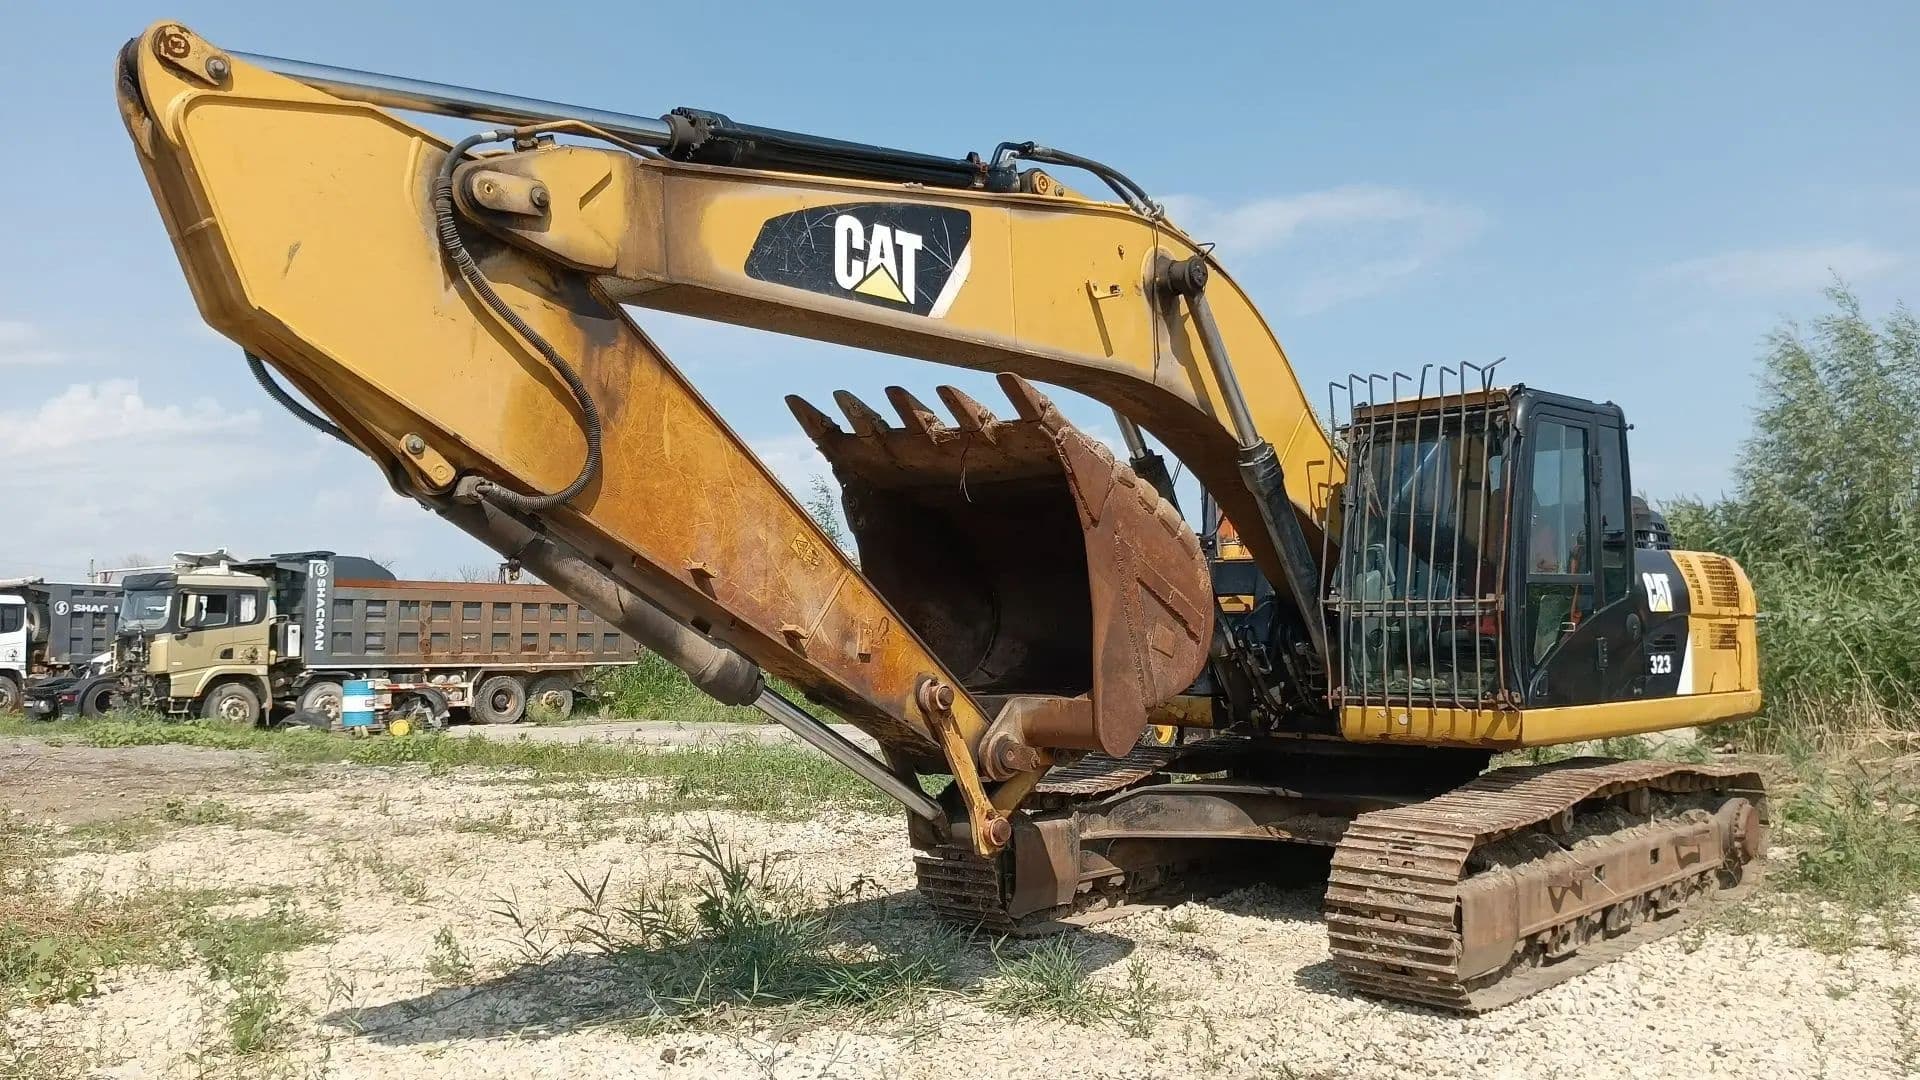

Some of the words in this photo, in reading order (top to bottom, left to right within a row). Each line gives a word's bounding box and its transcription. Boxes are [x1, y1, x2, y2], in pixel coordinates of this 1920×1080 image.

[834, 214, 923, 305] CAT
[315, 578, 326, 651] SHACMAN
[1642, 572, 1674, 613] CAT
[1650, 654, 1672, 675] 323
